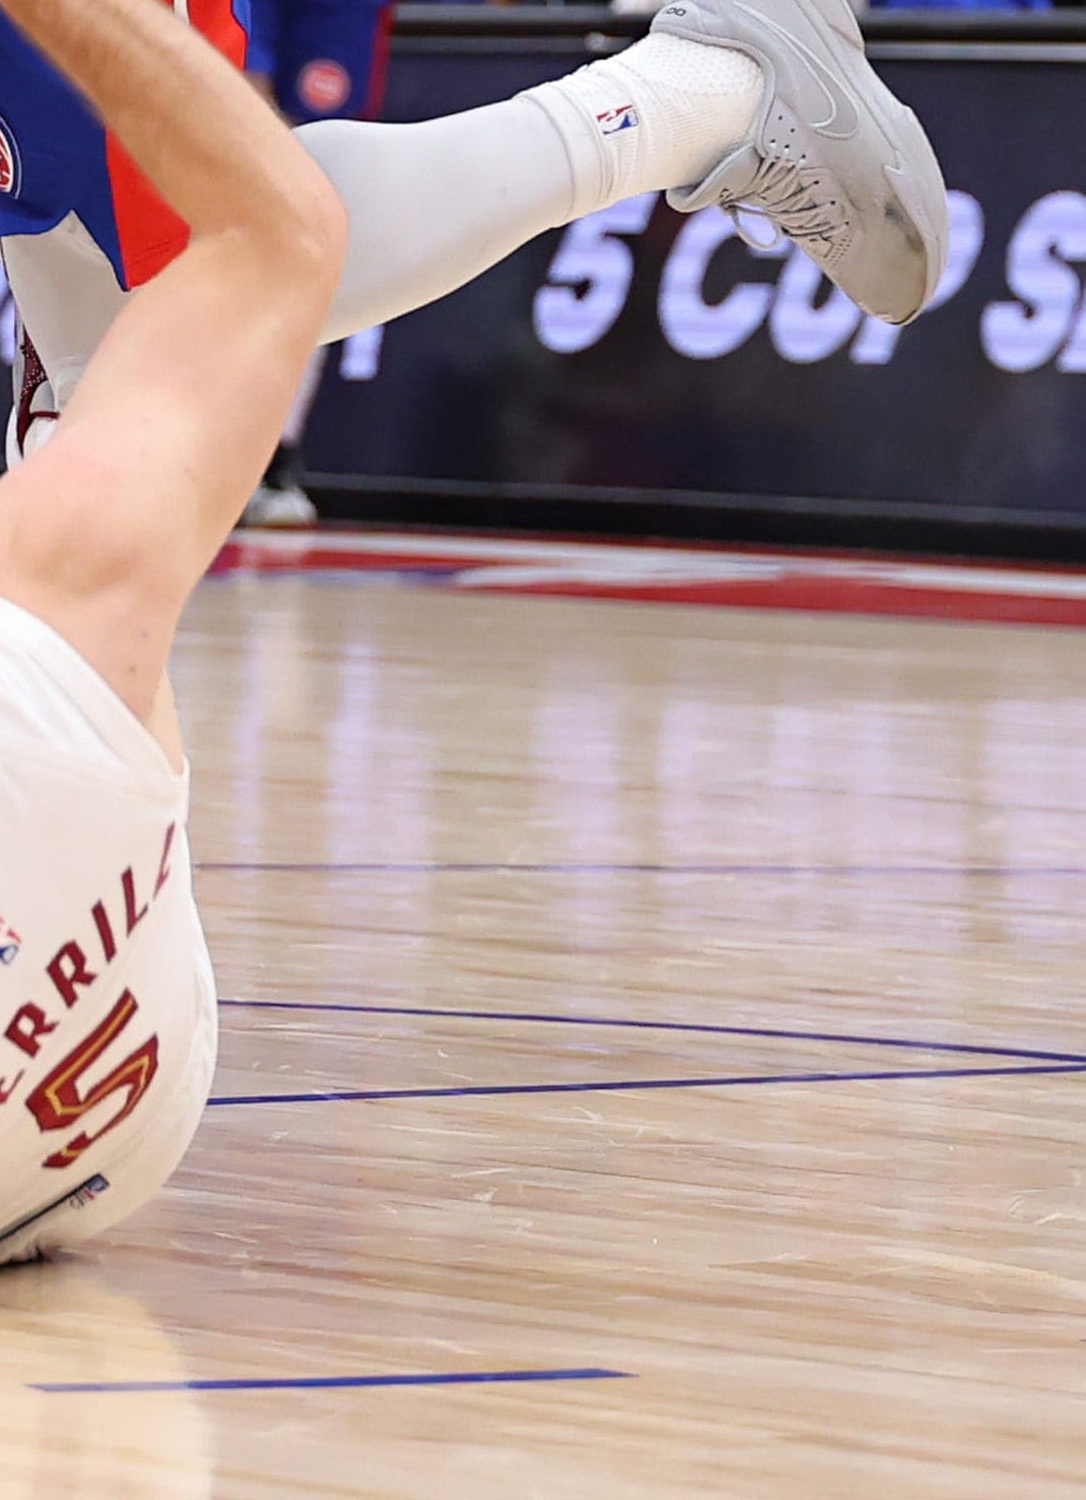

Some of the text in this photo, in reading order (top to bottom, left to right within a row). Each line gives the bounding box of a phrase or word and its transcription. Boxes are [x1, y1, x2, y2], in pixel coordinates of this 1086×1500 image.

[532, 191, 661, 354] 5
[981, 189, 1086, 374] S
[25, 987, 159, 1169] 5
